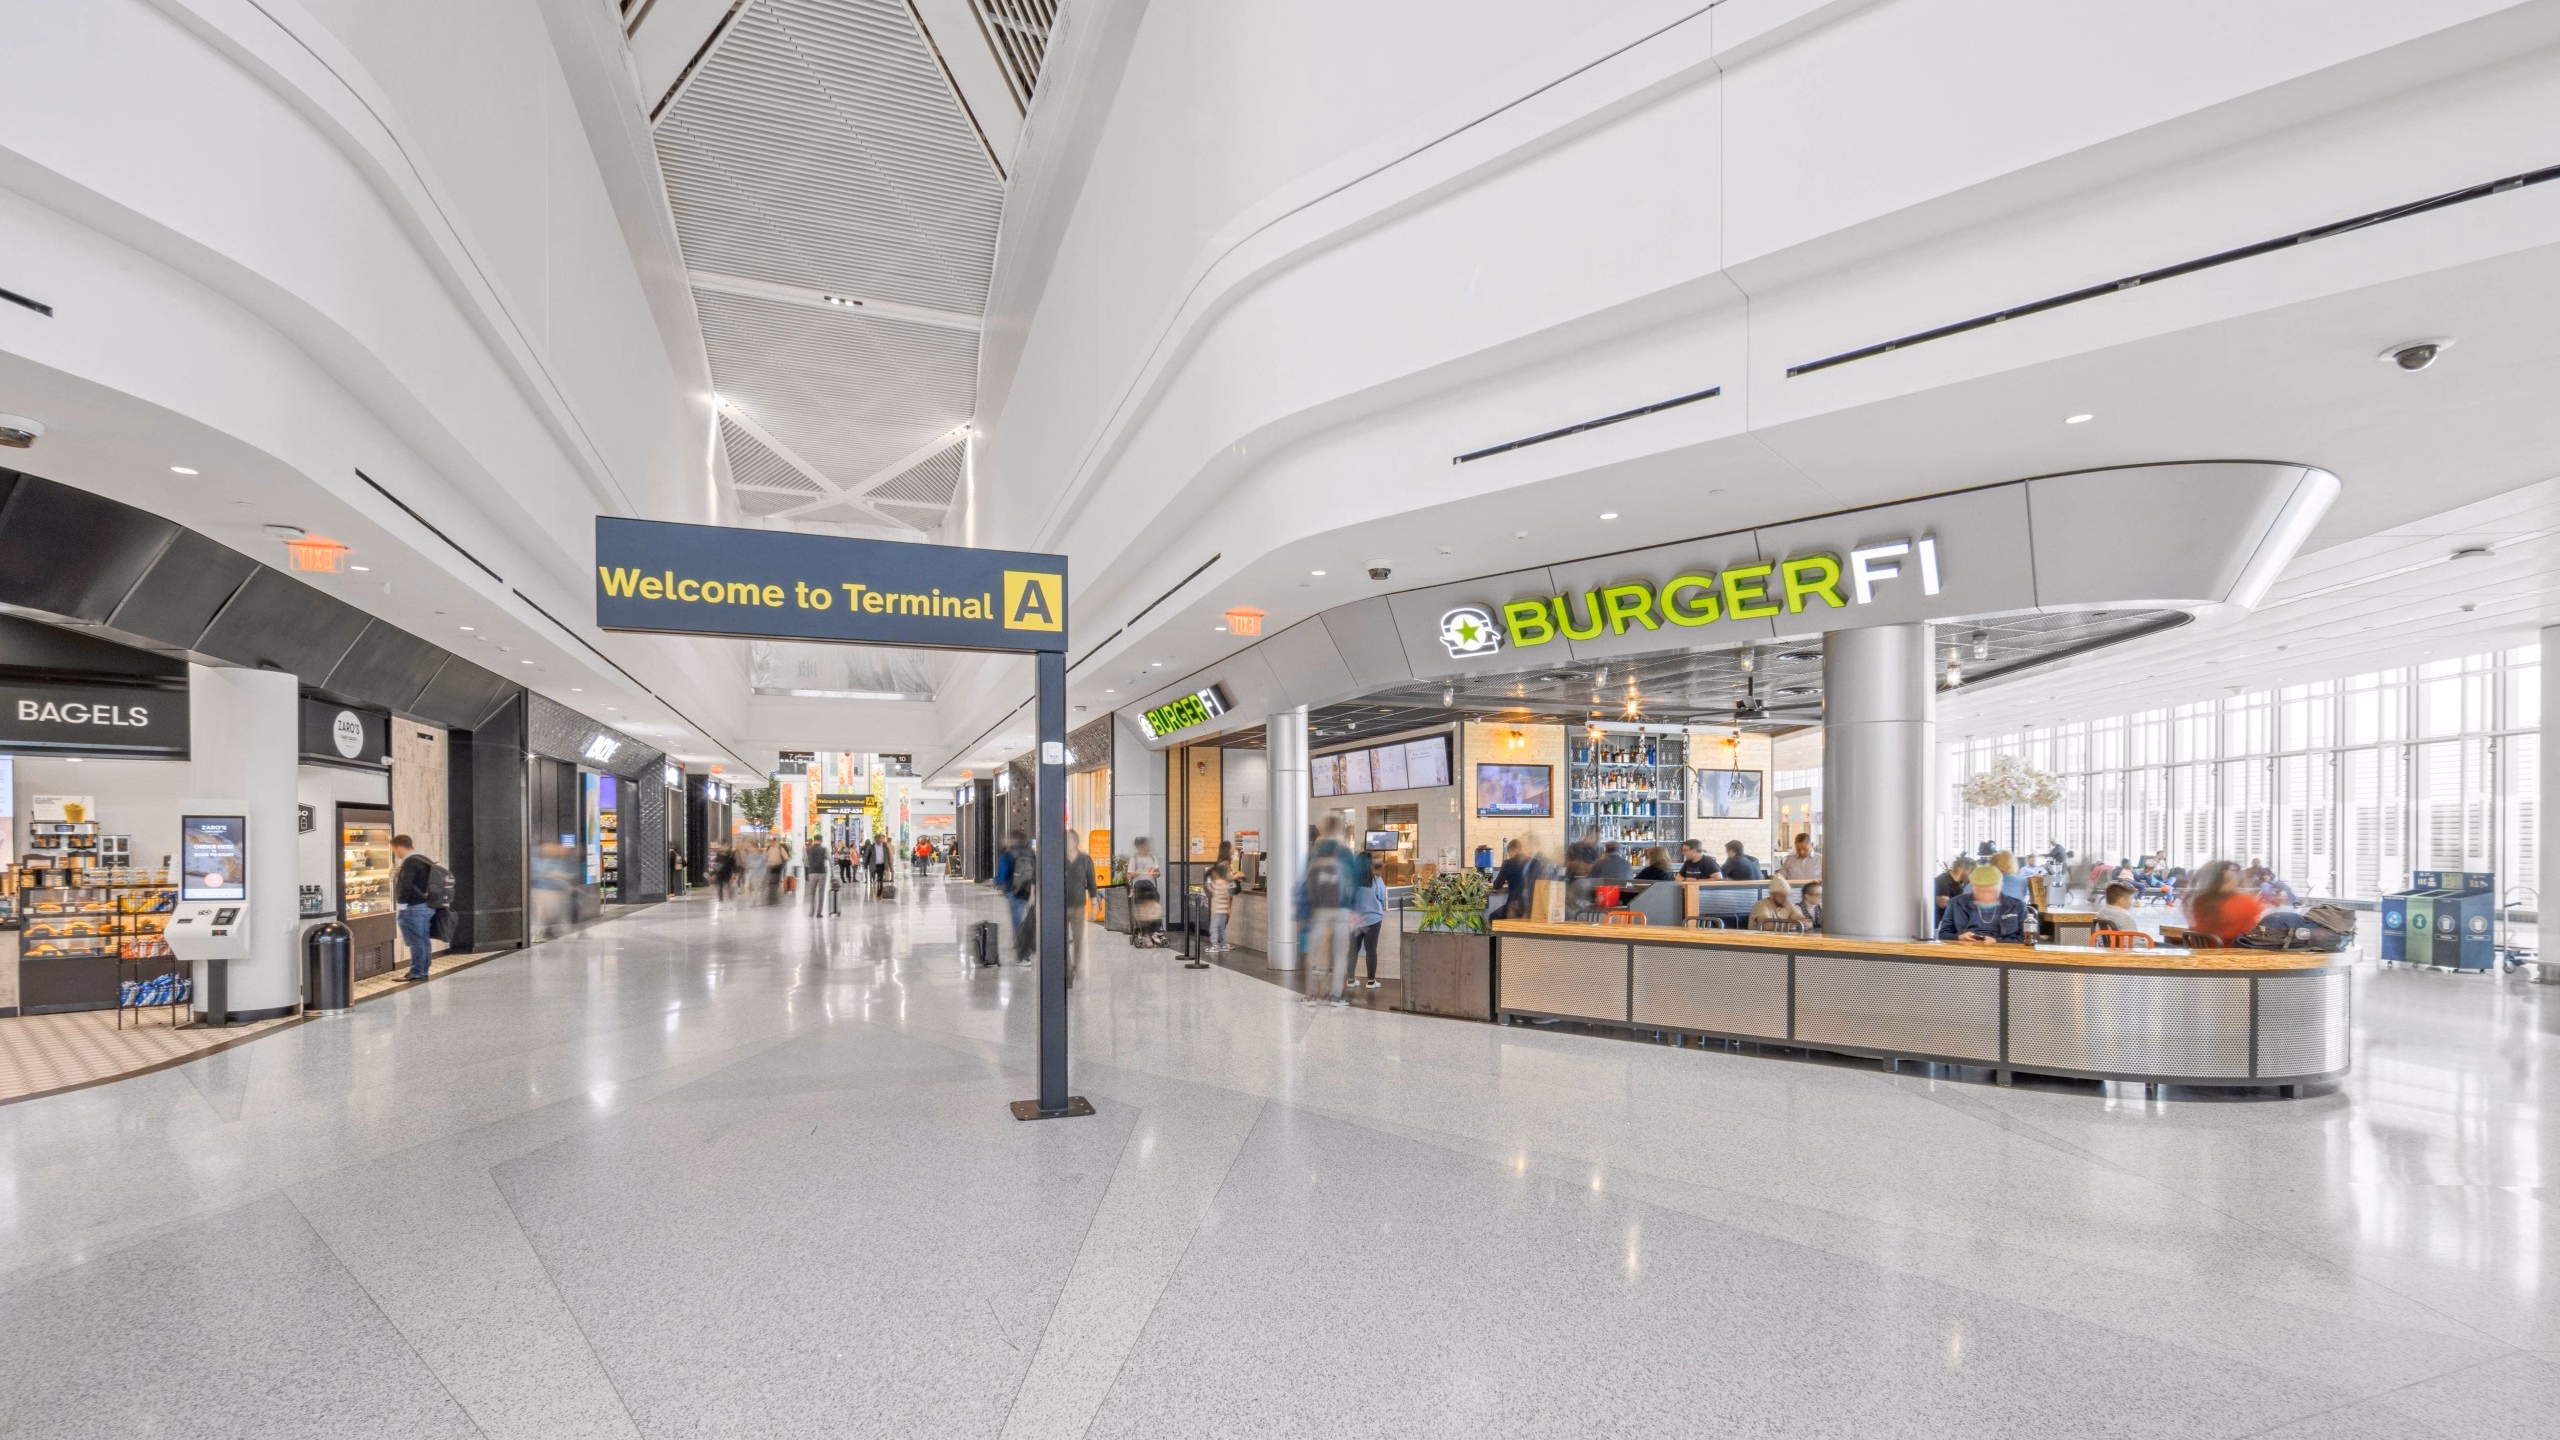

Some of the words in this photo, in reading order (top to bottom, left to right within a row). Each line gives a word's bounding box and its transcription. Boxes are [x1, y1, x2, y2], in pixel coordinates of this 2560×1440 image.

[599, 566, 785, 608] Welcome
[796, 581, 832, 610] to
[842, 583, 994, 620] Terminal
[1013, 579, 1055, 625] A
[1503, 533, 1942, 648] BURGERFI
[18, 700, 149, 727] BAGELS
[337, 720, 360, 735] ZARO'S
[1147, 688, 1225, 736] BURGERFI
